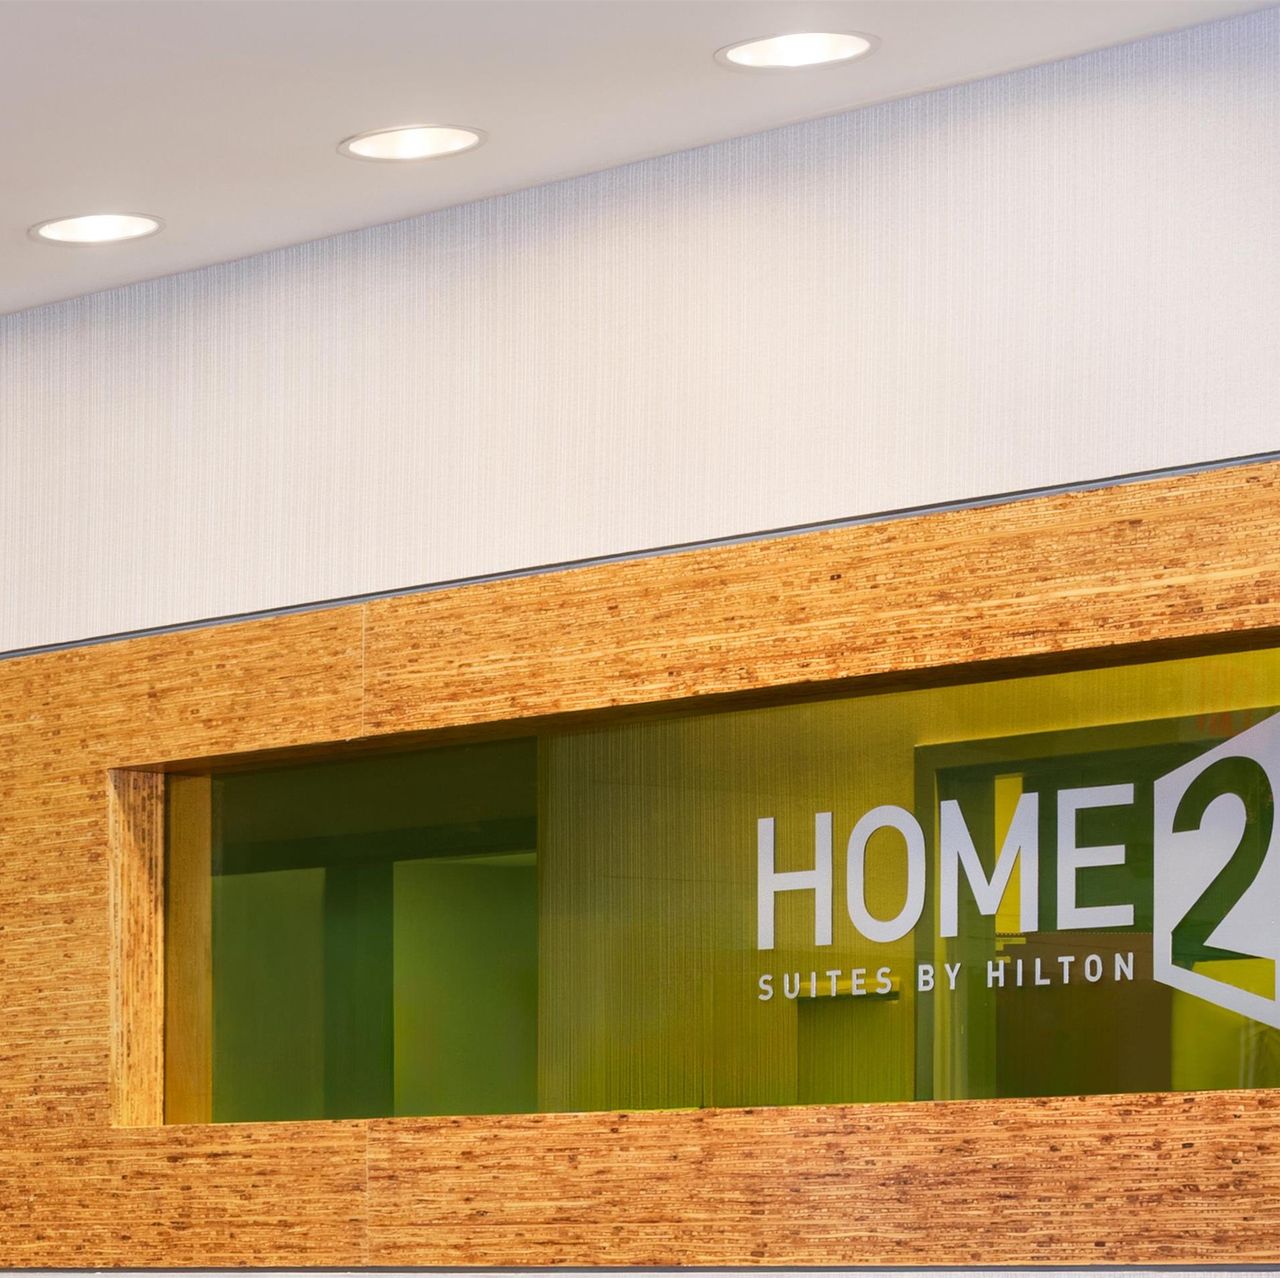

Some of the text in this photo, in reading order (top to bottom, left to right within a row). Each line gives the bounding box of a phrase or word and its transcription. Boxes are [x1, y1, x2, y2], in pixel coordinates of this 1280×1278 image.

[758, 952, 1134, 1001] SUITES BY HILTON
